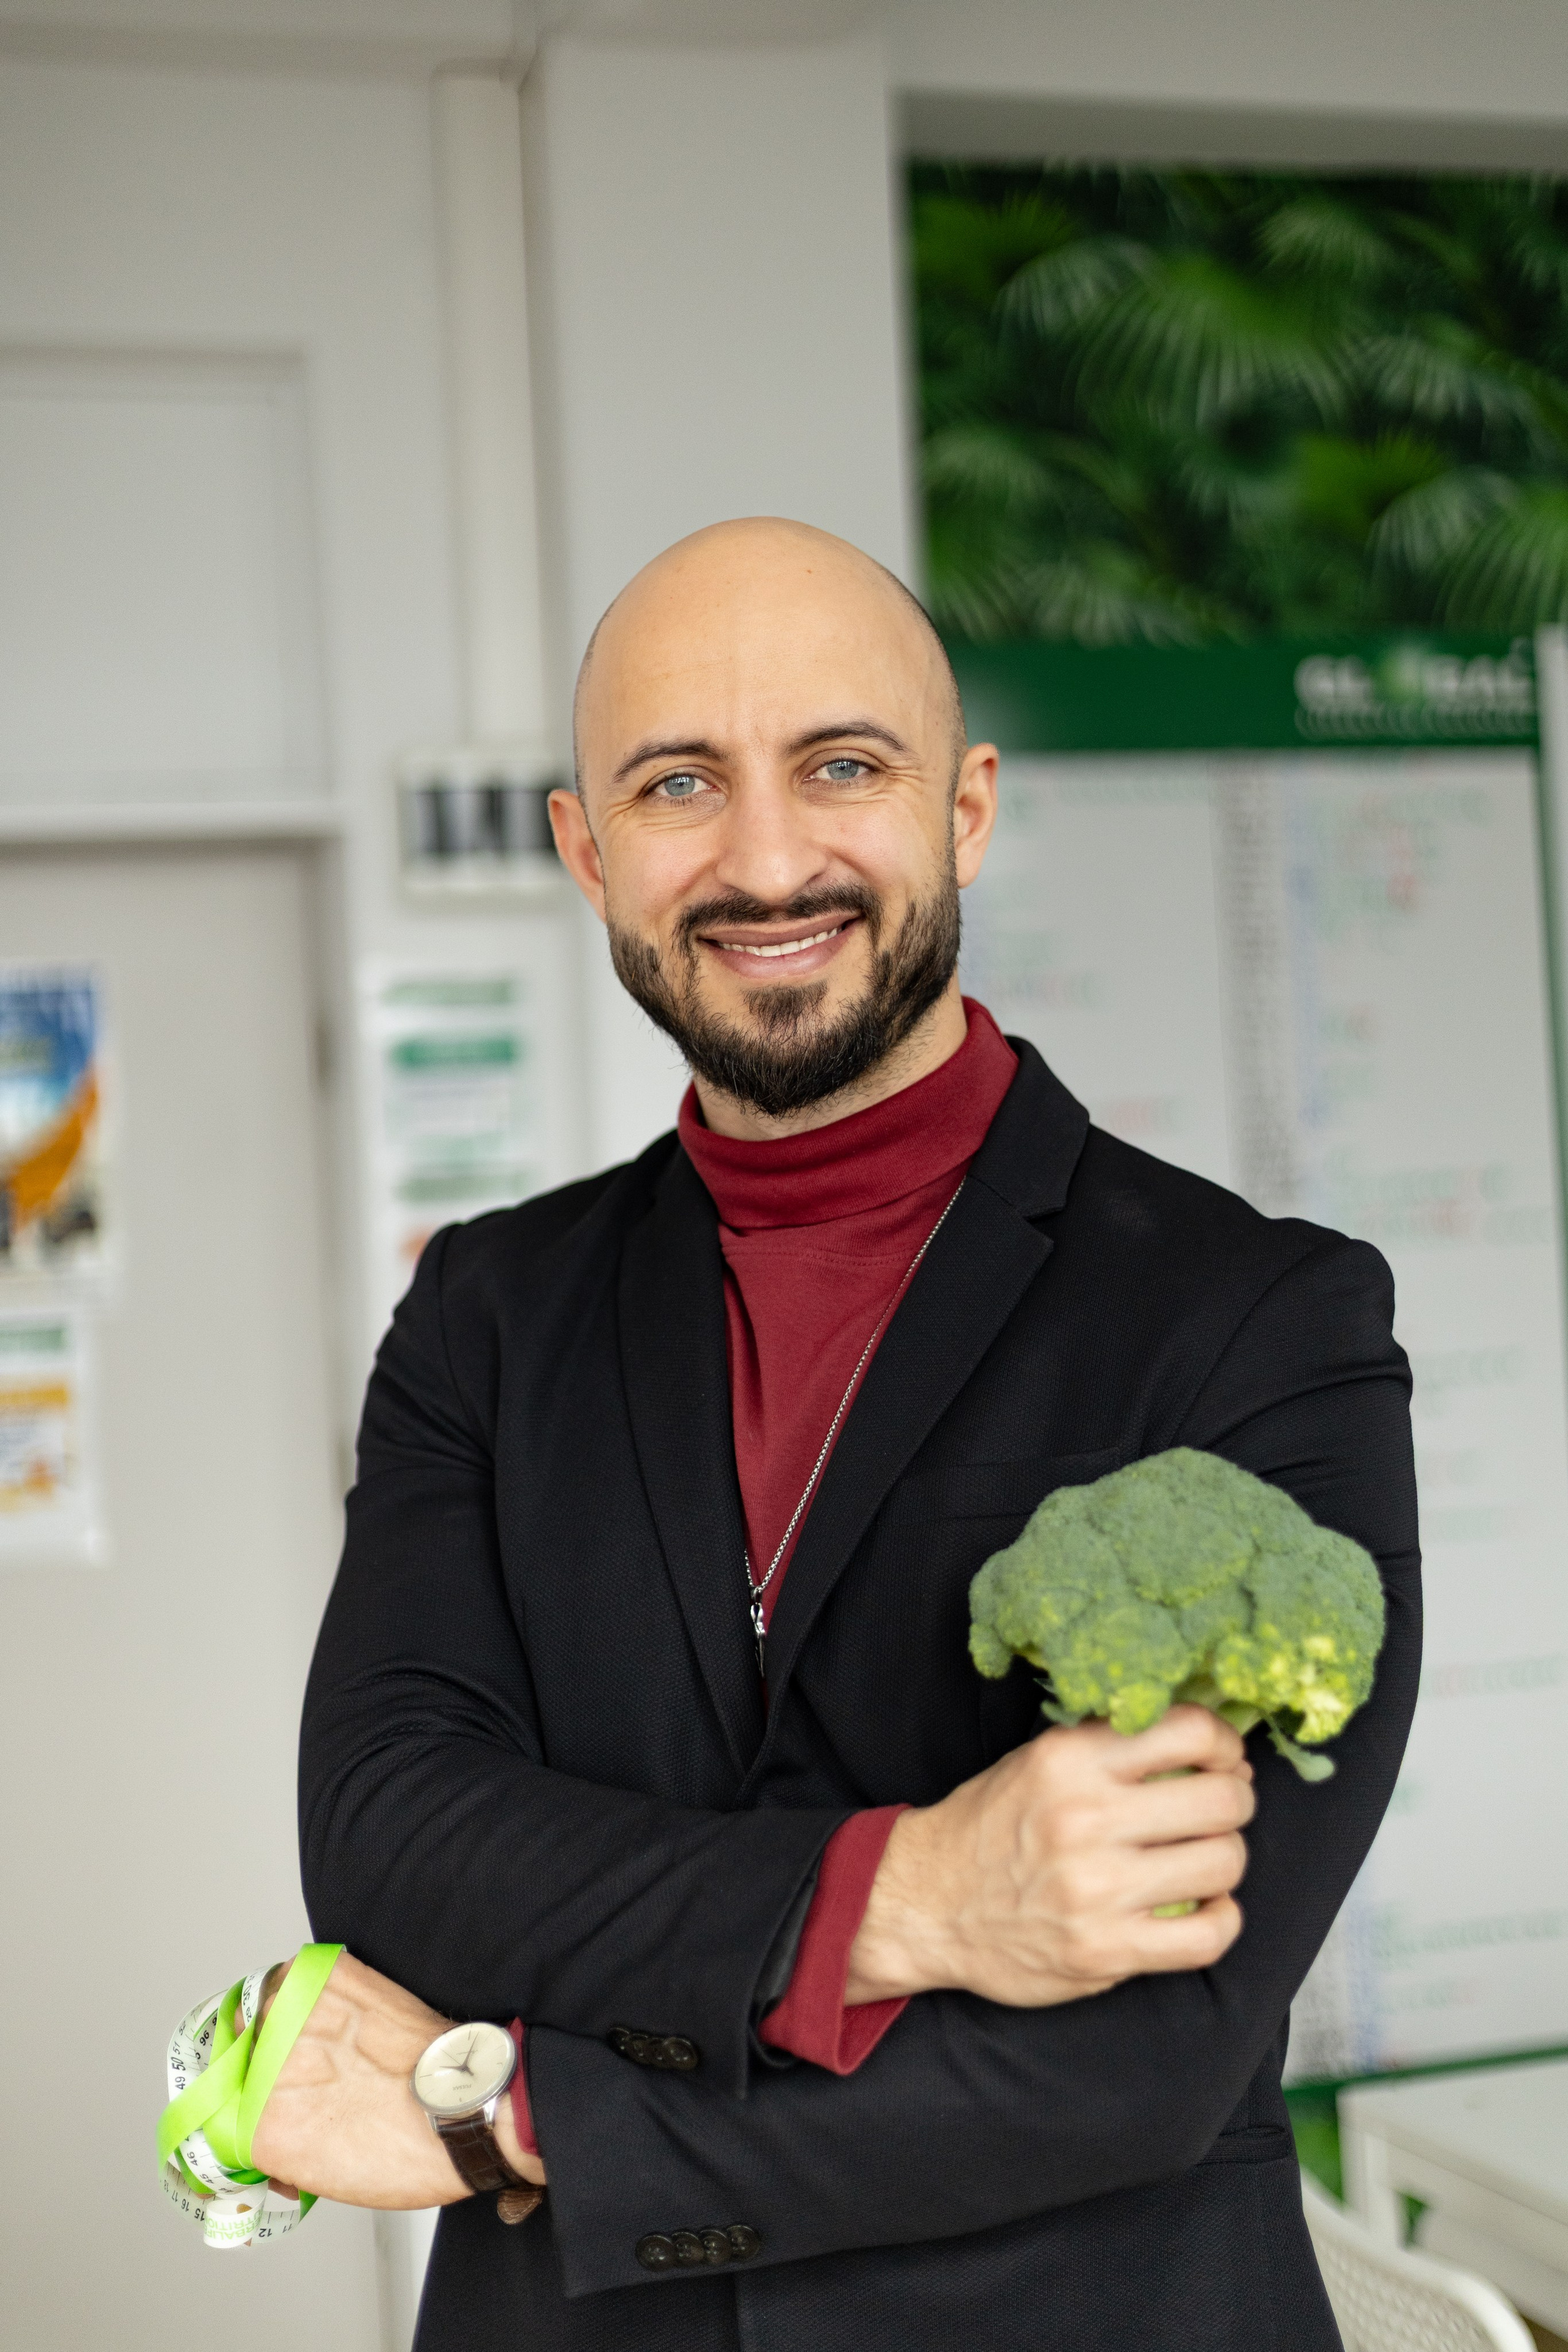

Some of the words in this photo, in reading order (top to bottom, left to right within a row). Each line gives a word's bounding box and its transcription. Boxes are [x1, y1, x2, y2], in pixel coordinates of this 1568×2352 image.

[243, 1984, 252, 2006] 30
[200, 2030, 209, 2046] 96
[173, 2041, 181, 2055] 51
[171, 2057, 186, 2071] 50
[175, 2076, 186, 2090] 49
[187, 2152, 198, 2166] 46
[164, 2179, 169, 2193] 18
[200, 2174, 214, 2184] 45
[172, 2190, 178, 2203] 17
[181, 2198, 189, 2212] 16
[194, 2208, 205, 2222] 15
[206, 2209, 262, 2231] UTRITIO
[205, 2218, 260, 2240] ERBALIF
[258, 2228, 273, 2237] 12
[282, 2223, 293, 2233] 11
